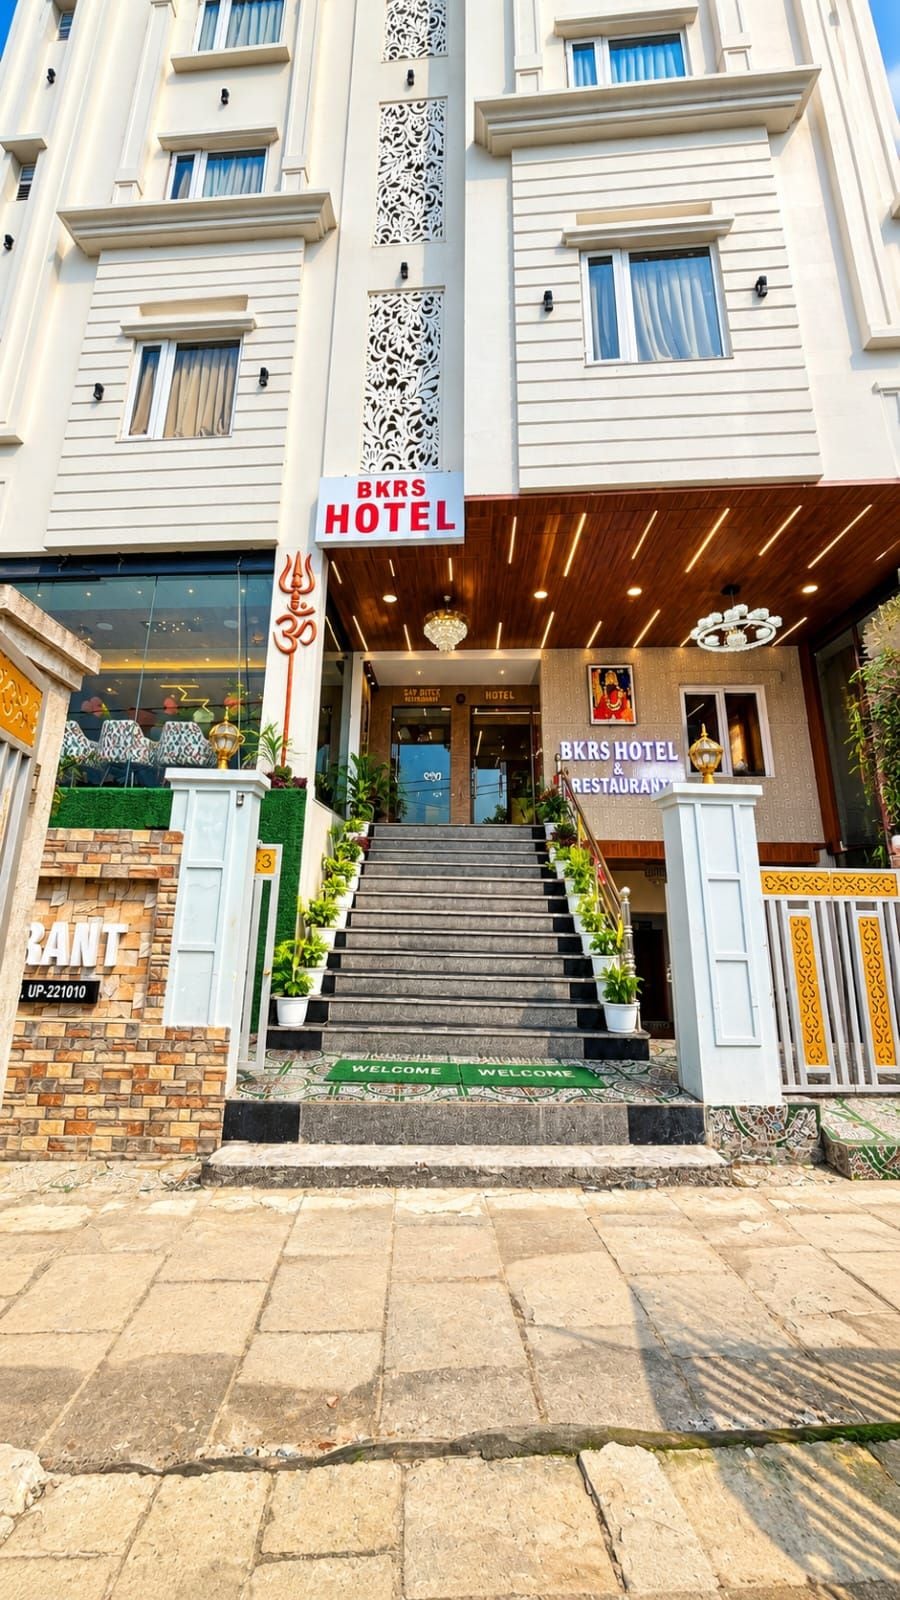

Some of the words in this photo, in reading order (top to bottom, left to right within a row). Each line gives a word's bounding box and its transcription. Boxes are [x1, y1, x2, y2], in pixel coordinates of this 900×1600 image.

[357, 478, 426, 499] BKRS
[324, 500, 456, 535] HOTEL
[485, 690, 515, 700] HOTEL
[560, 740, 610, 761] BKRS
[614, 740, 679, 761] HOTEL
[613, 761, 624, 776] &
[28, 984, 86, 999] UP-221010
[352, 1064, 442, 1075] WELCOME
[478, 1068, 576, 1079] WELCOME
